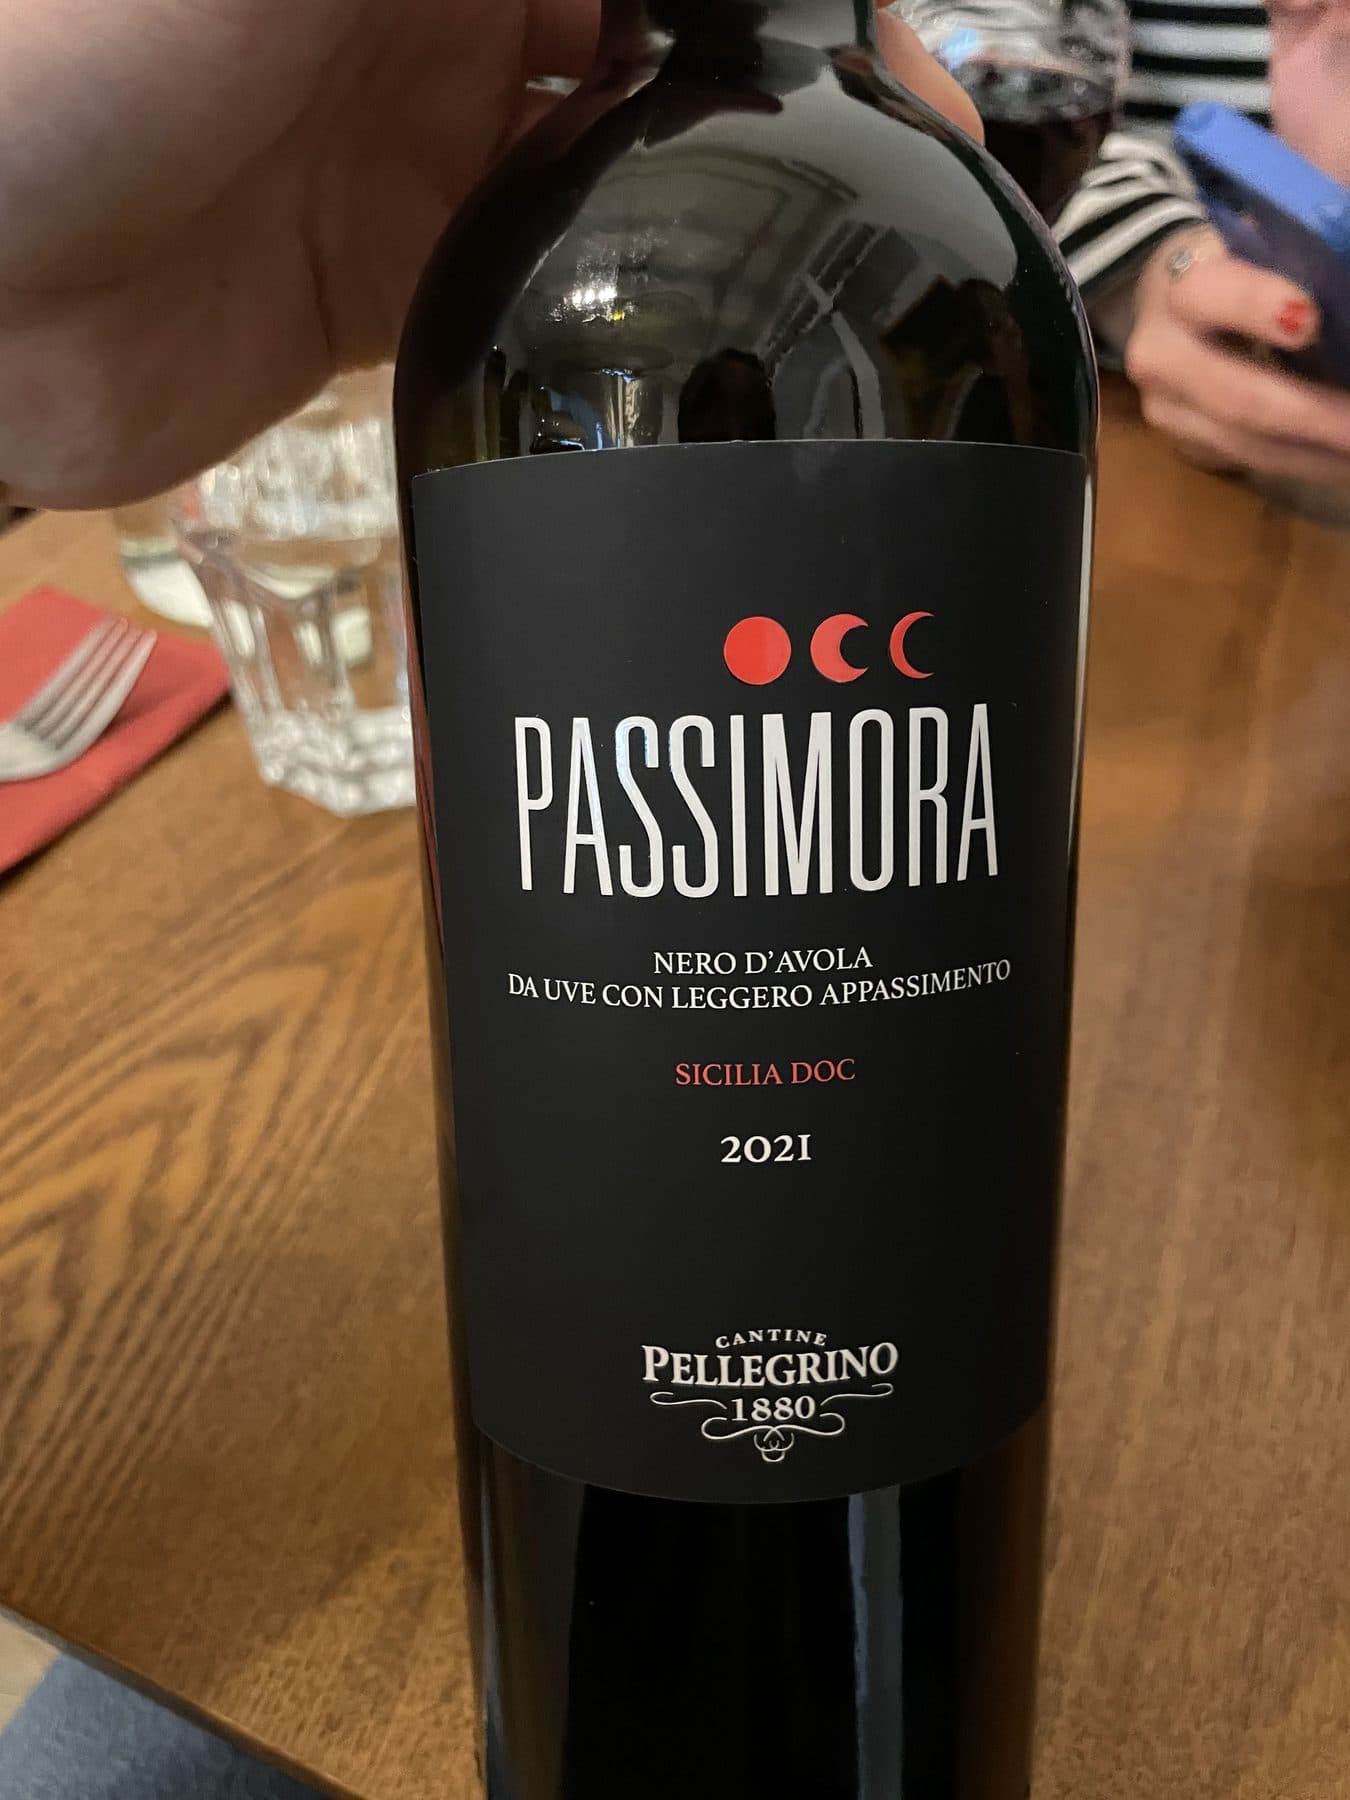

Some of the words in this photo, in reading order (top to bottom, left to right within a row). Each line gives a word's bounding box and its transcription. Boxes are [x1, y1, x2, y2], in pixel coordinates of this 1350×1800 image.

[514, 703, 998, 897] PASSIMORA
[653, 951, 737, 975] NERO
[744, 946, 874, 975] D'AVOLA
[507, 972, 540, 999] DA
[543, 978, 597, 1005] UVE
[602, 983, 664, 1009] CON
[671, 984, 813, 1010] LEGGERO
[819, 959, 1011, 1005] APPASSIMENTO
[675, 1063, 783, 1086] SICILIA
[790, 1058, 856, 1084] DOC
[720, 1133, 812, 1163] 2021
[715, 1328, 827, 1349] CANTINE
[641, 1342, 898, 1386] PELLEGRINO
[731, 1395, 816, 1422] 1880
